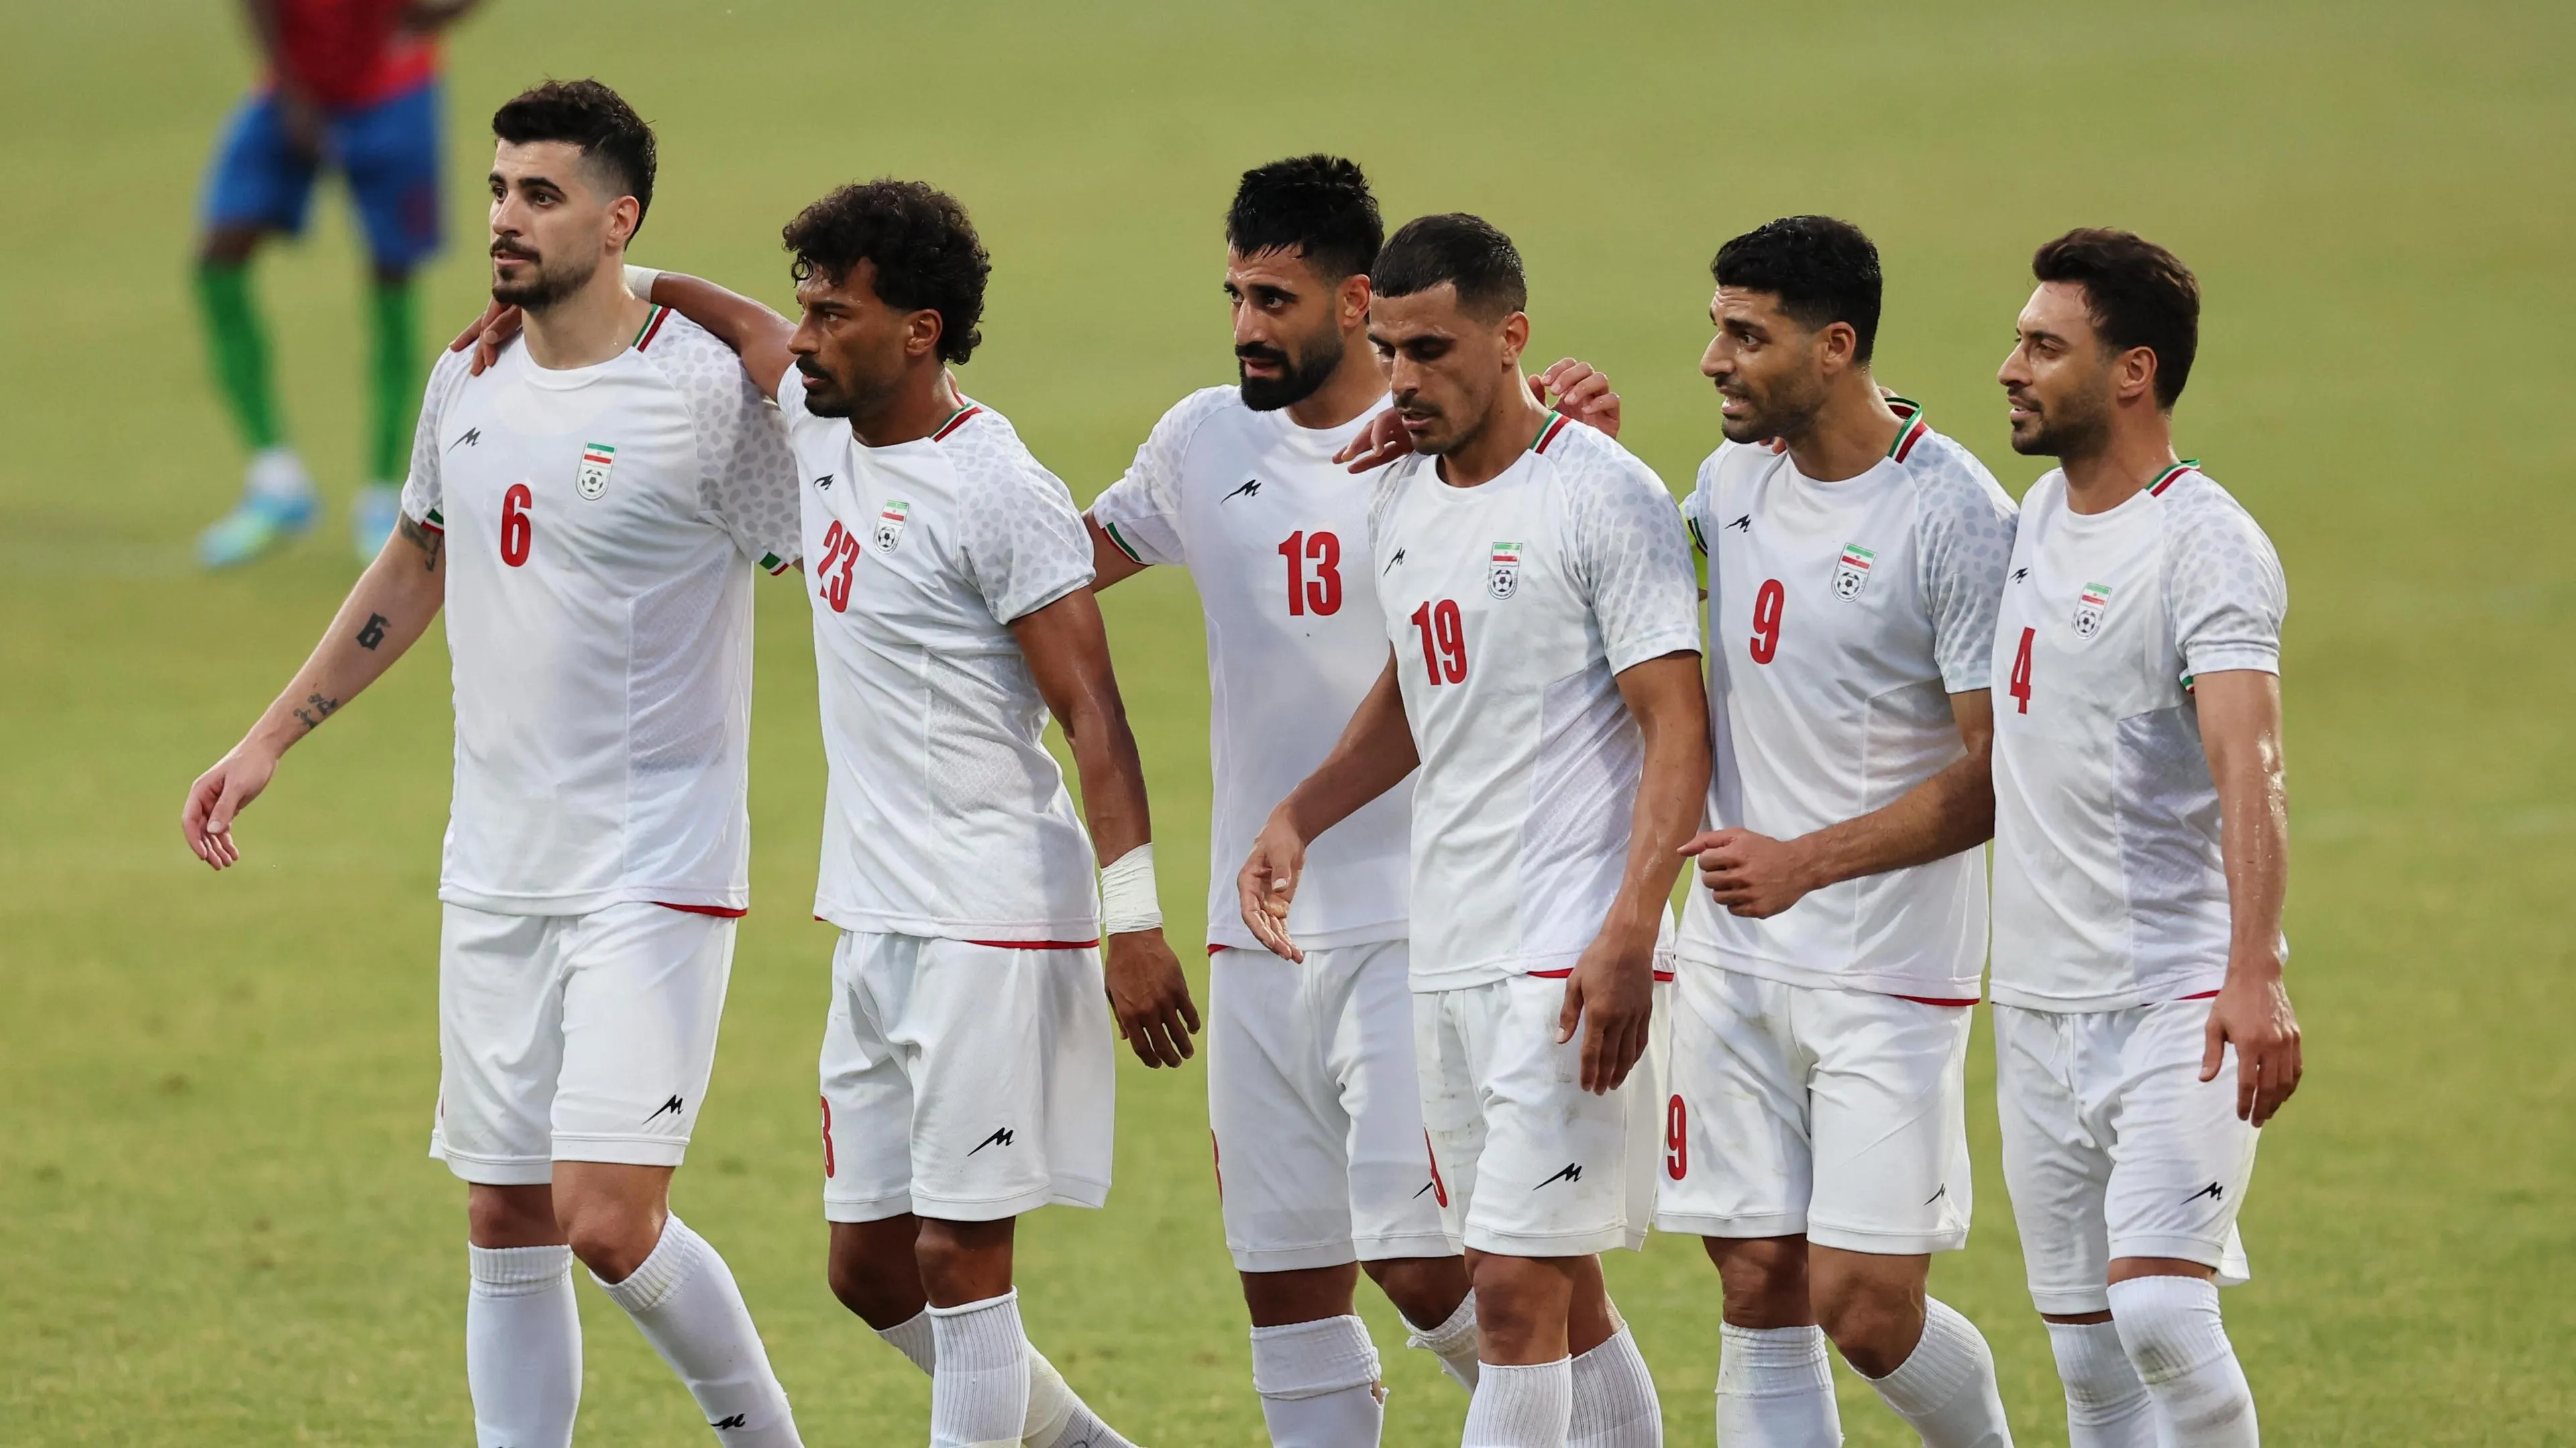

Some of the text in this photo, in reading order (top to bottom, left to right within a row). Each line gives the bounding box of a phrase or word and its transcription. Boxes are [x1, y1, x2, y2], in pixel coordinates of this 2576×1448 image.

[500, 483, 532, 567] 6
[817, 520, 861, 613] 23
[1279, 531, 1342, 616] 13
[1411, 599, 1468, 685] 19
[1750, 579, 1784, 664] 9
[2010, 627, 2035, 714] 4
[1667, 1095, 1687, 1180] 9
